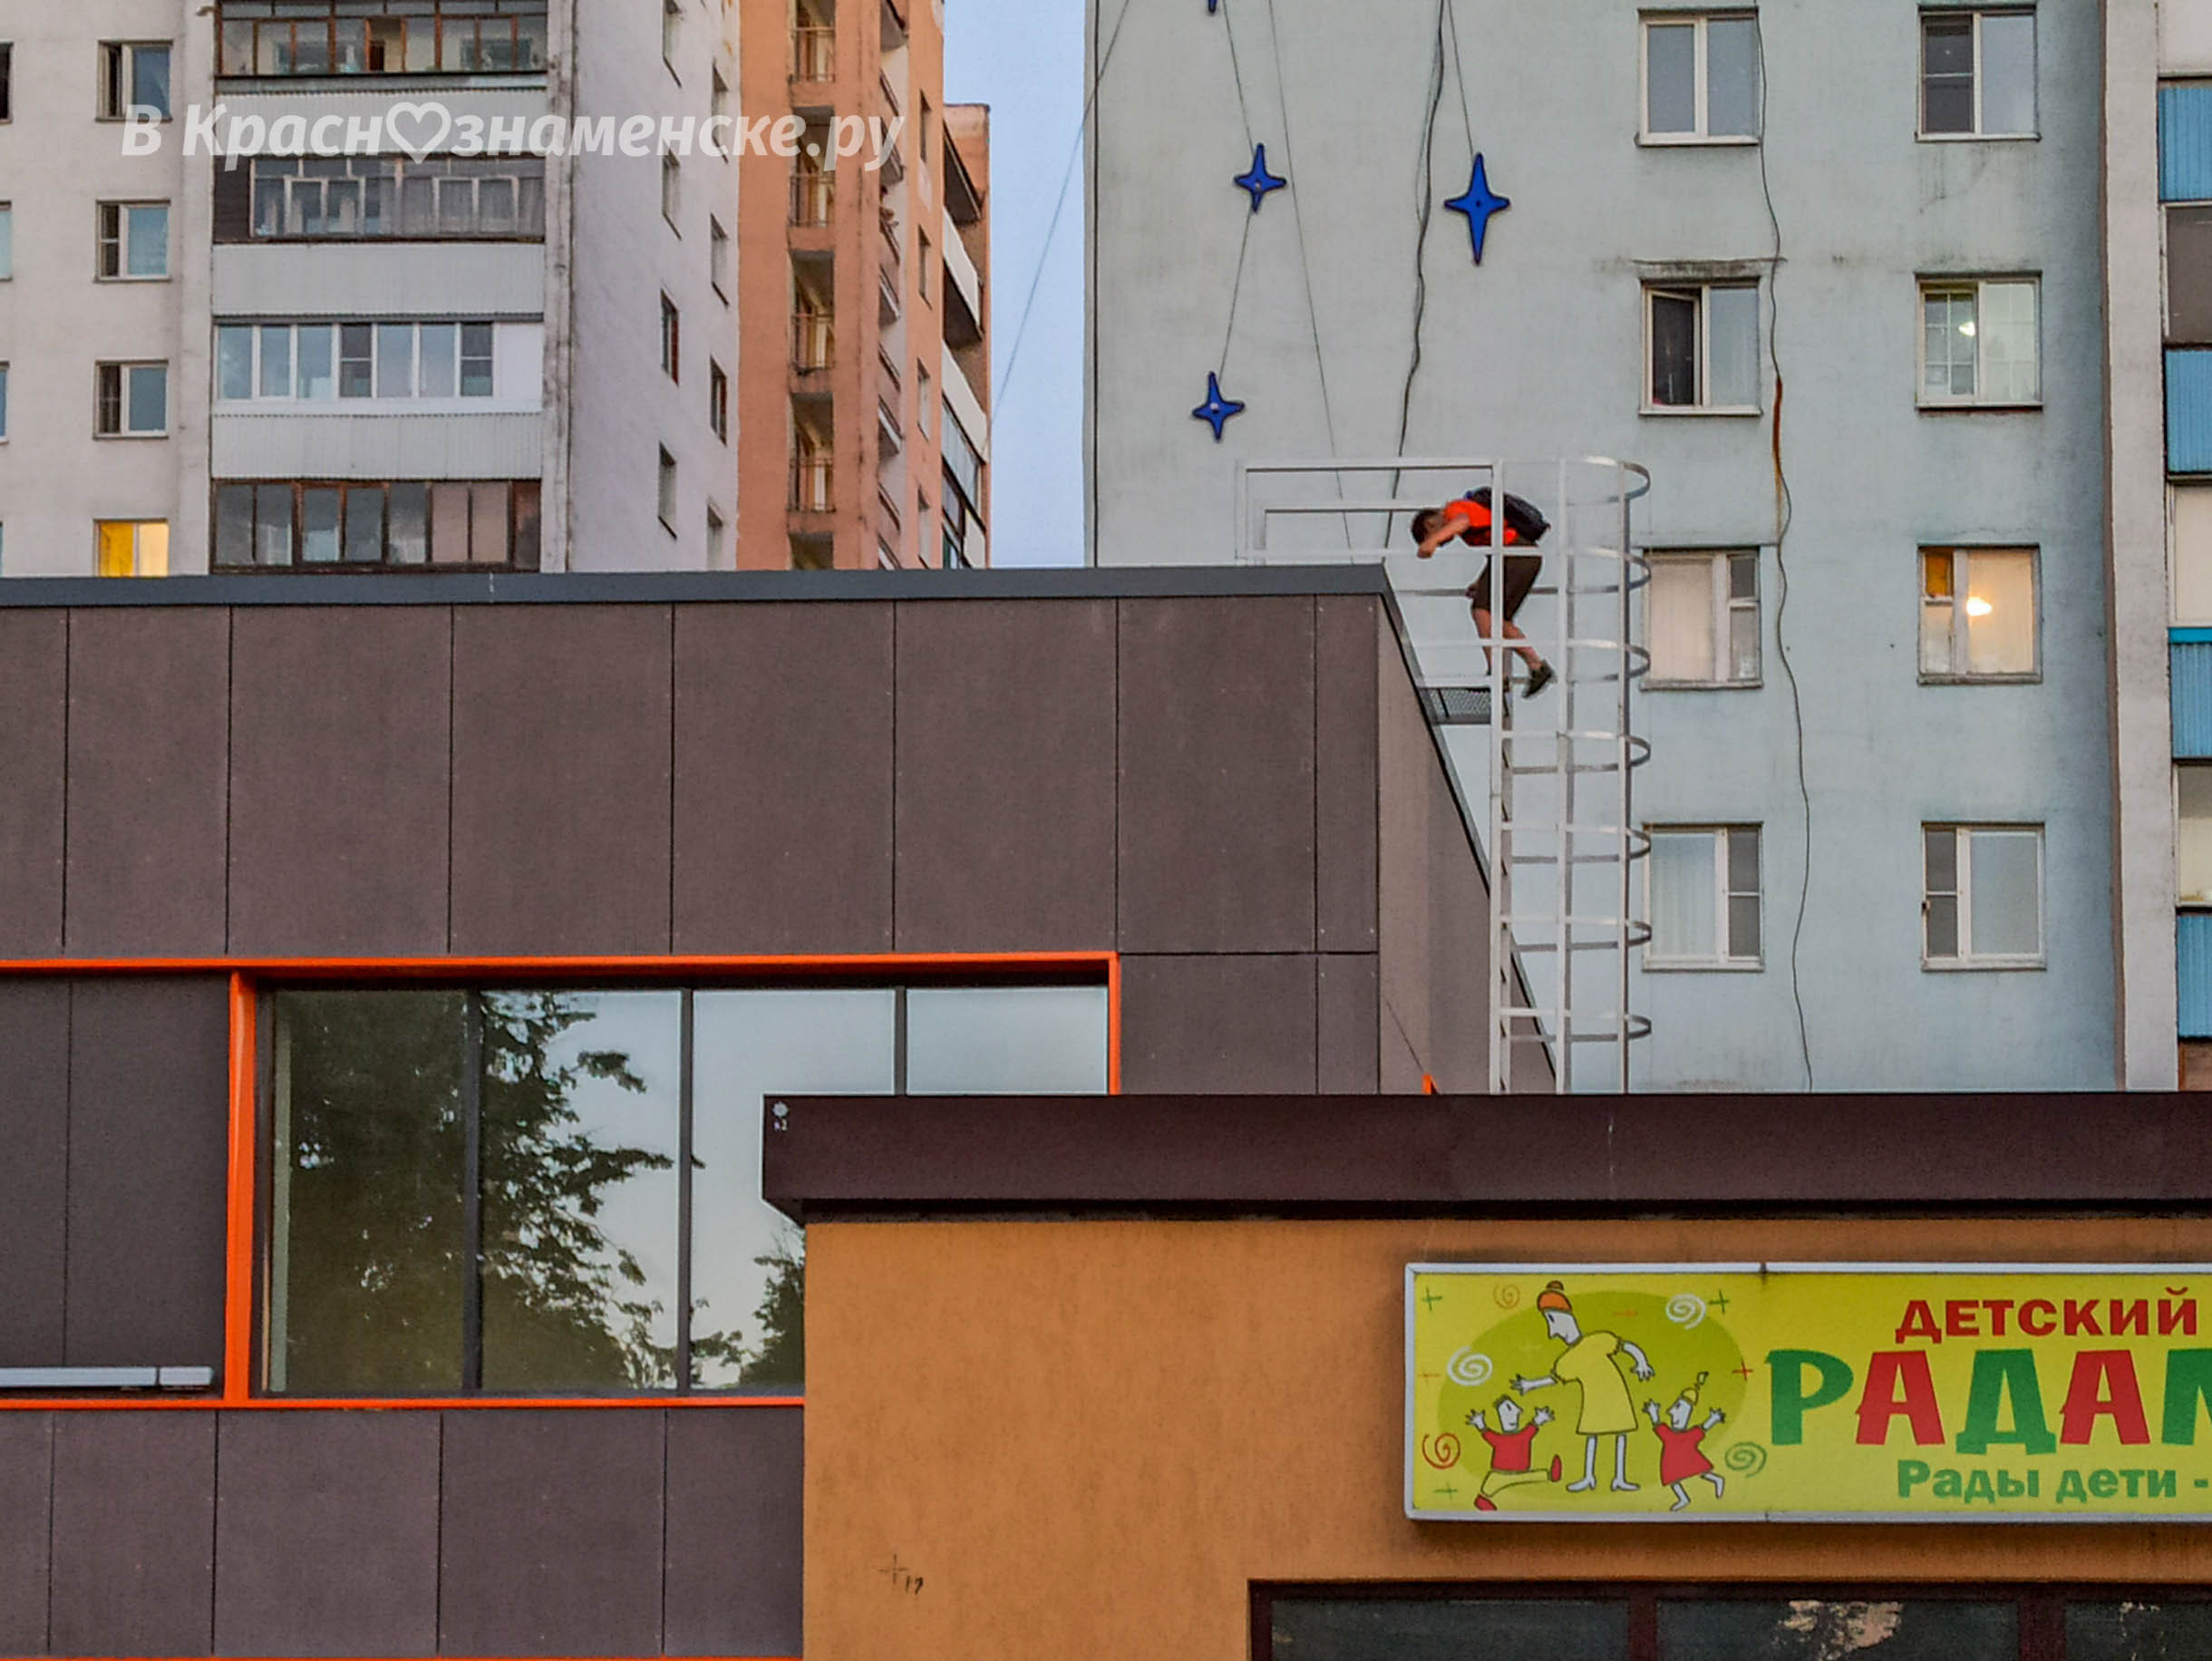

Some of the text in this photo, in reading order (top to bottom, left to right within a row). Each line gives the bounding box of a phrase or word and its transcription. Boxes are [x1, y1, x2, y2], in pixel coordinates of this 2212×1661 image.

[1895, 1287, 2197, 1345] ДЕТСКИЙ
[1897, 1459, 2040, 1504] Рады
[2055, 1468, 2177, 1504] дети
